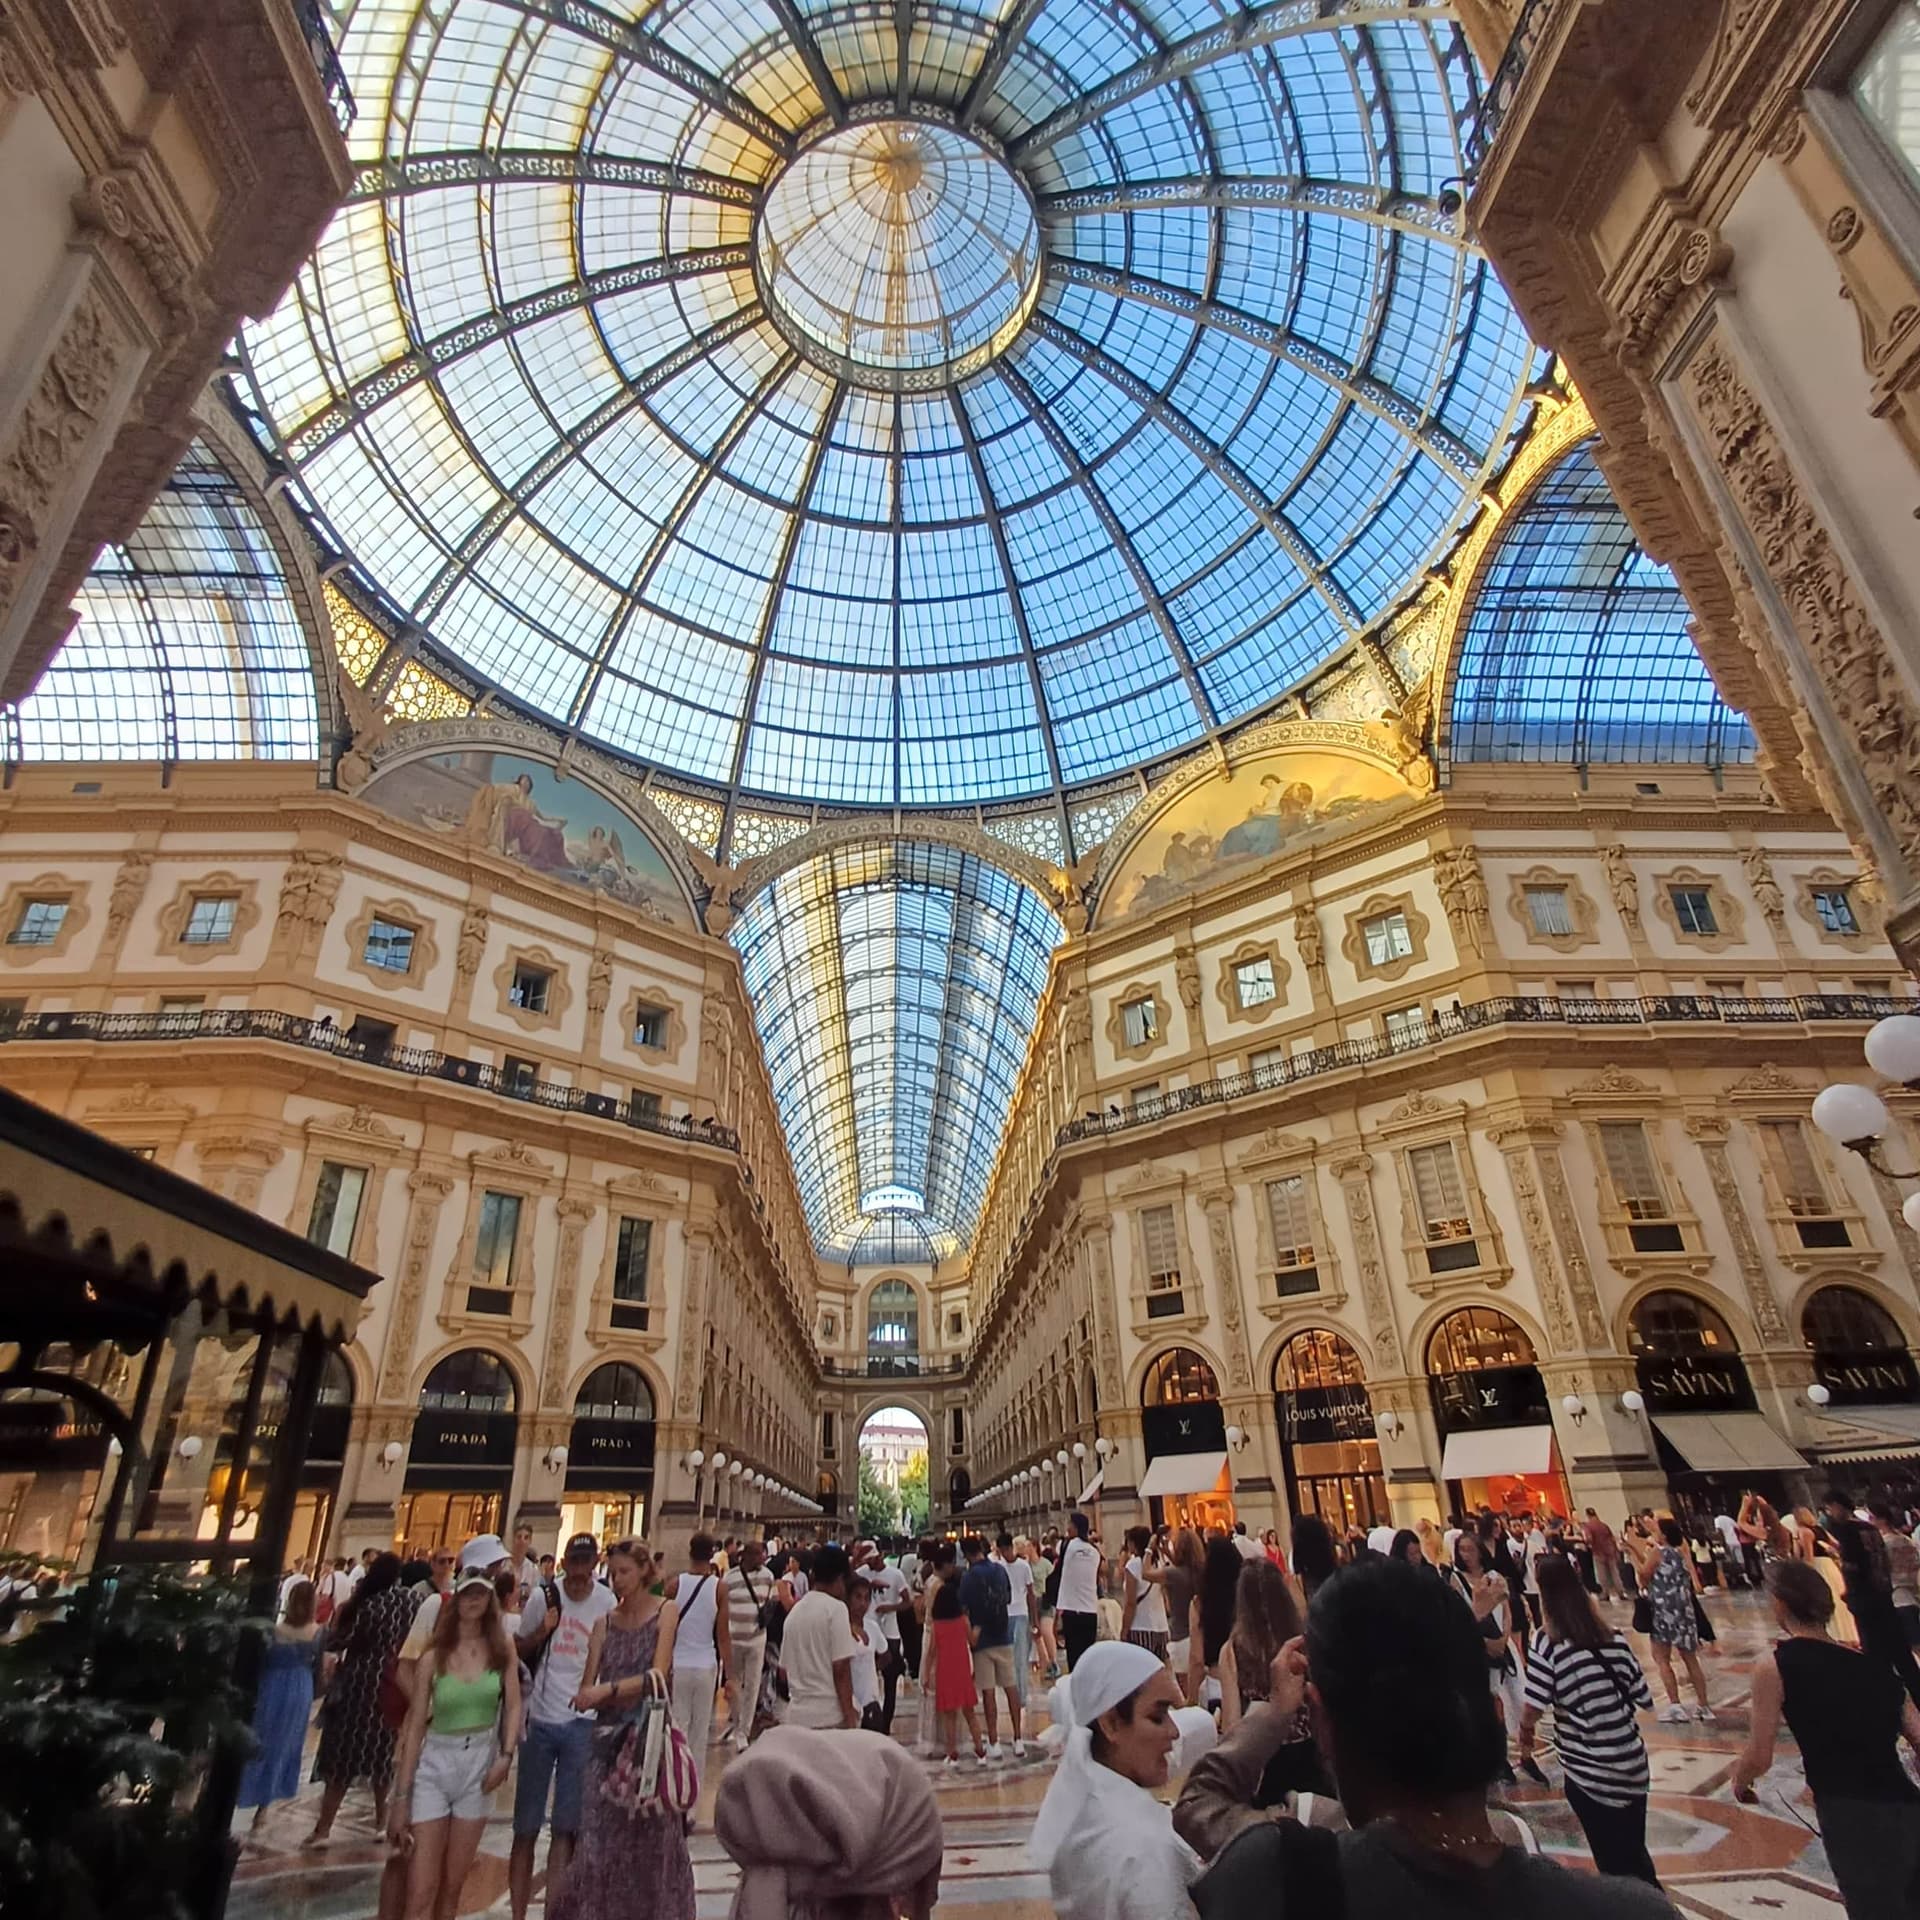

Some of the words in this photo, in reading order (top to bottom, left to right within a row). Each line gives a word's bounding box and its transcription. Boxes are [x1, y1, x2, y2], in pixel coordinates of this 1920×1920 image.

[1286, 1408, 1317, 1422] LOUIS
[1319, 1403, 1366, 1419] VUITTON
[440, 1432, 487, 1445] PRADA
[591, 1437, 632, 1449] PRADA
